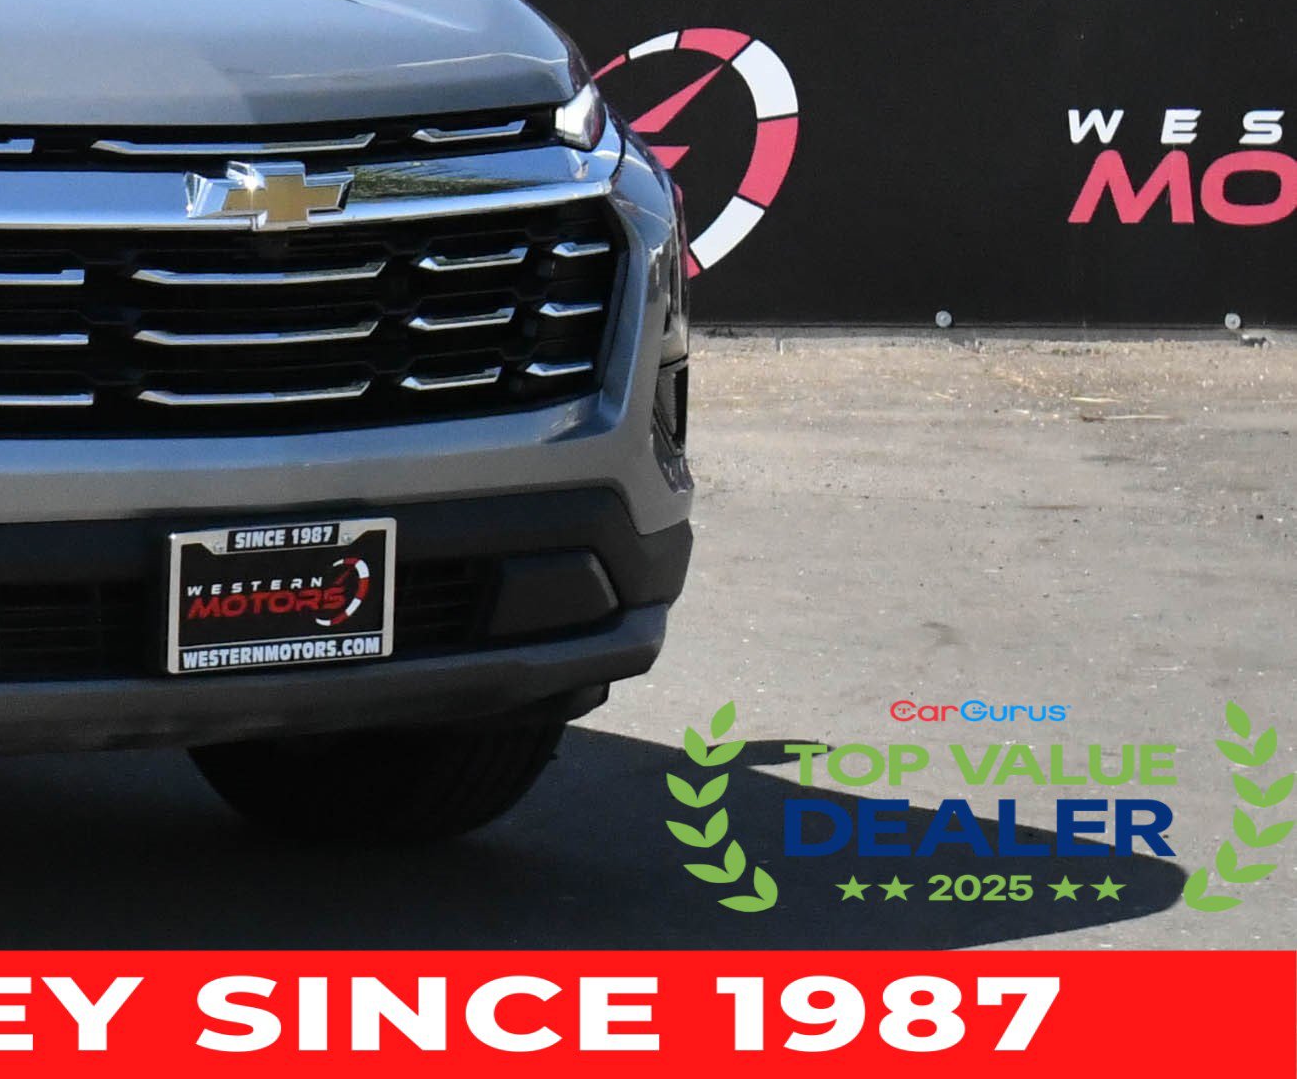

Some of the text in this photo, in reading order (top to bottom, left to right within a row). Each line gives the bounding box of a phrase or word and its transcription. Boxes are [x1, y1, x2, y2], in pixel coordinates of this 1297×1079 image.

[234, 526, 333, 549] SINCE 1987
[187, 576, 323, 596] WESTERN
[188, 585, 346, 619] MOTORS
[183, 636, 381, 669] WESTERNMOTORS.COM
